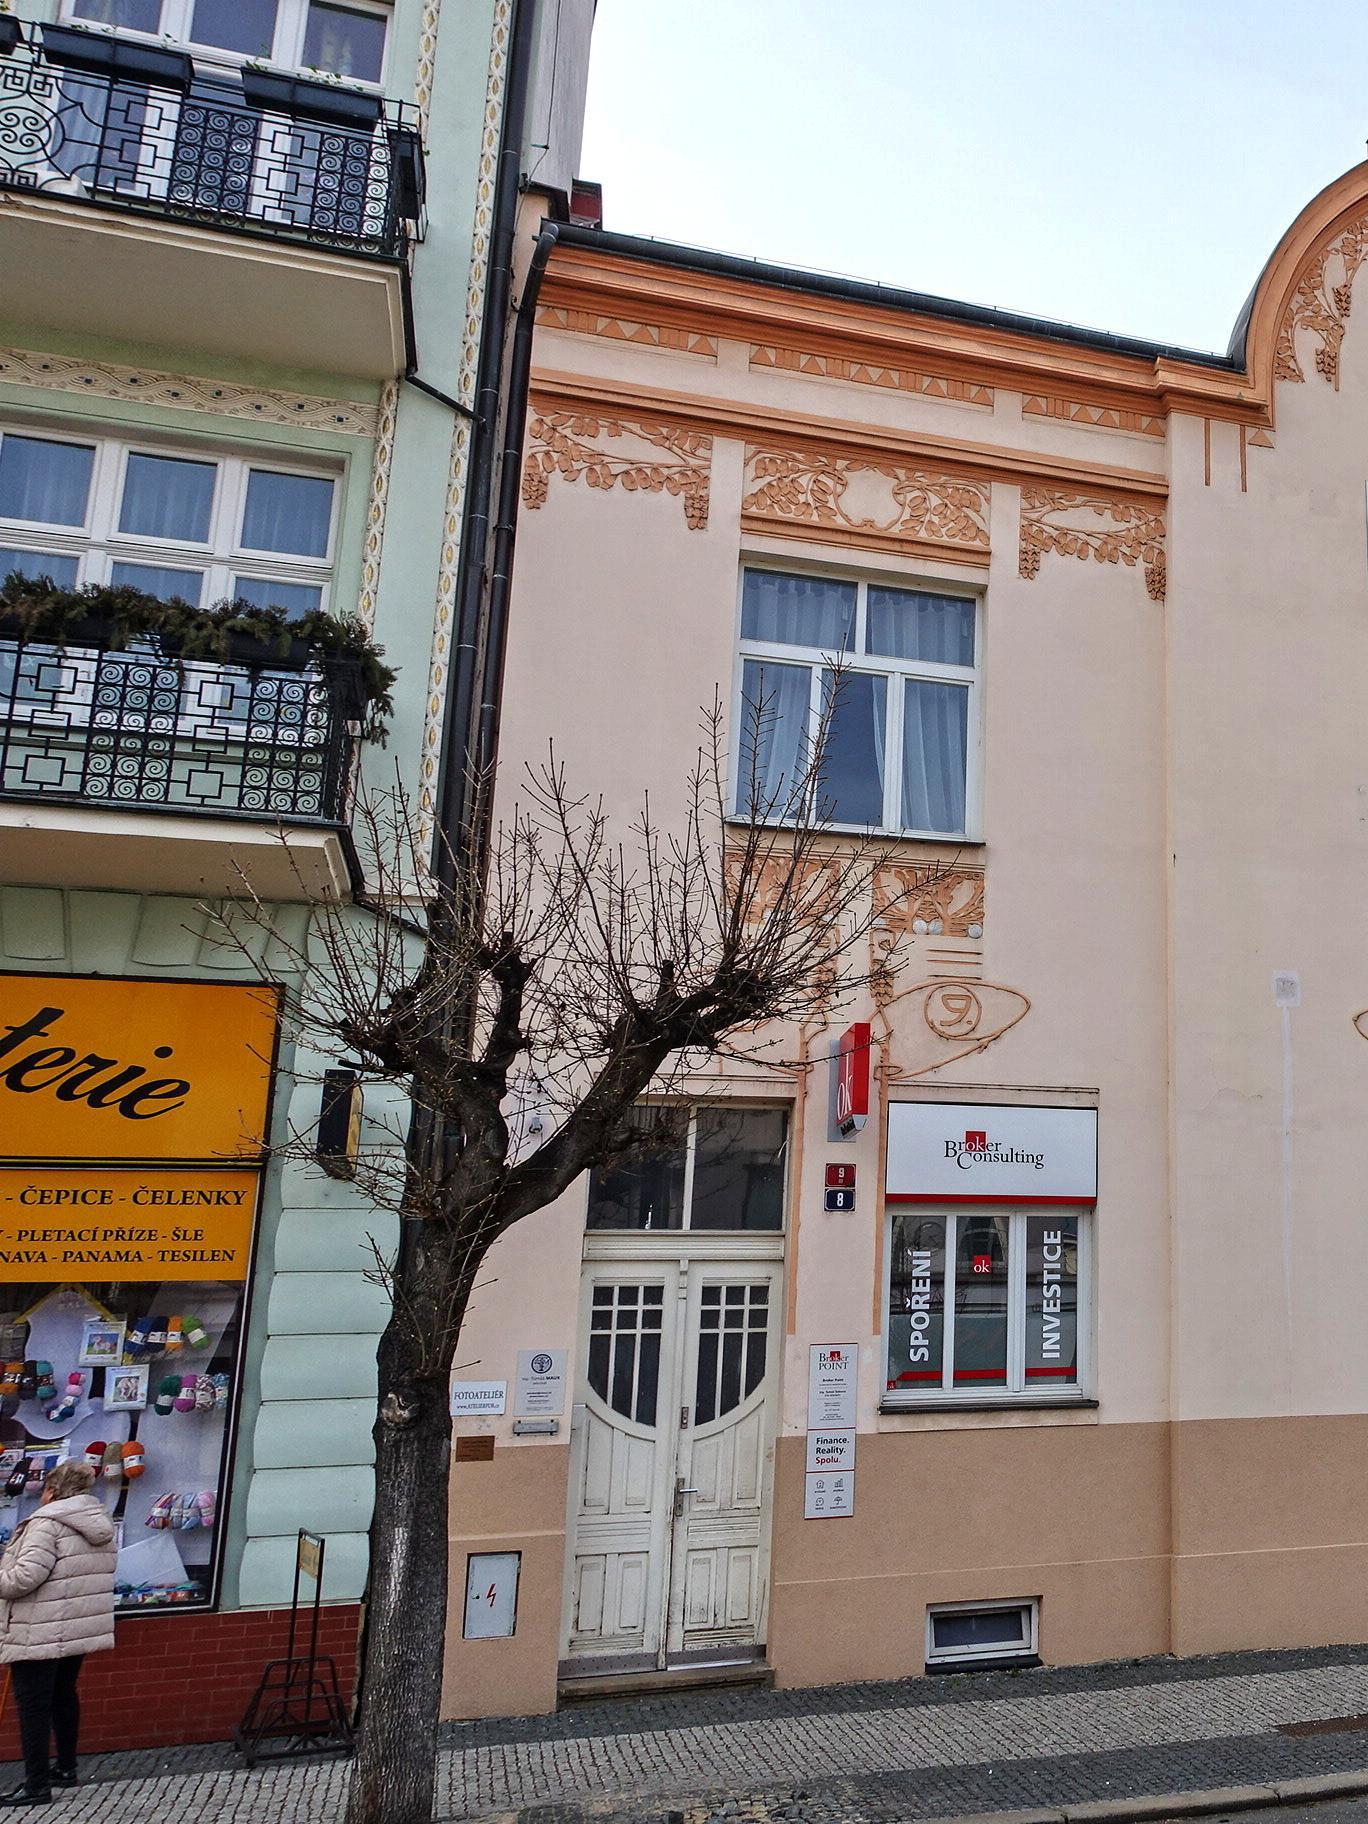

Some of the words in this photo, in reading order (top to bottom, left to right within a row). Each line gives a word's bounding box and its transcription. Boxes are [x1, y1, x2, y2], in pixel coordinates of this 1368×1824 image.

[837, 1052, 853, 1121] ok
[944, 1136, 1002, 1157] Broker
[957, 1148, 1044, 1170] Consulting
[838, 1167, 845, 1178] 9
[20, 1185, 114, 1206] ČEPICE
[132, 1185, 247, 1206] ČELENKY
[836, 1192, 844, 1207] 8
[17, 1227, 98, 1242] PLETACÍ
[102, 1227, 158, 1242] PŘÍZE
[171, 1226, 204, 1242] ŠLE
[61, 1250, 142, 1264] PANAMA
[157, 1250, 236, 1263] TESILEN
[973, 1258, 991, 1273] ok
[1042, 1230, 1061, 1359] INVESTICE
[905, 1249, 931, 1362] SPOŘENÍ
[818, 1362, 849, 1371] POINT
[454, 1389, 504, 1400] FOTOATELIÉR
[816, 1437, 850, 1445] Finance.
[815, 1446, 847, 1456] Reality.
[815, 1456, 841, 1466] Spolu.
